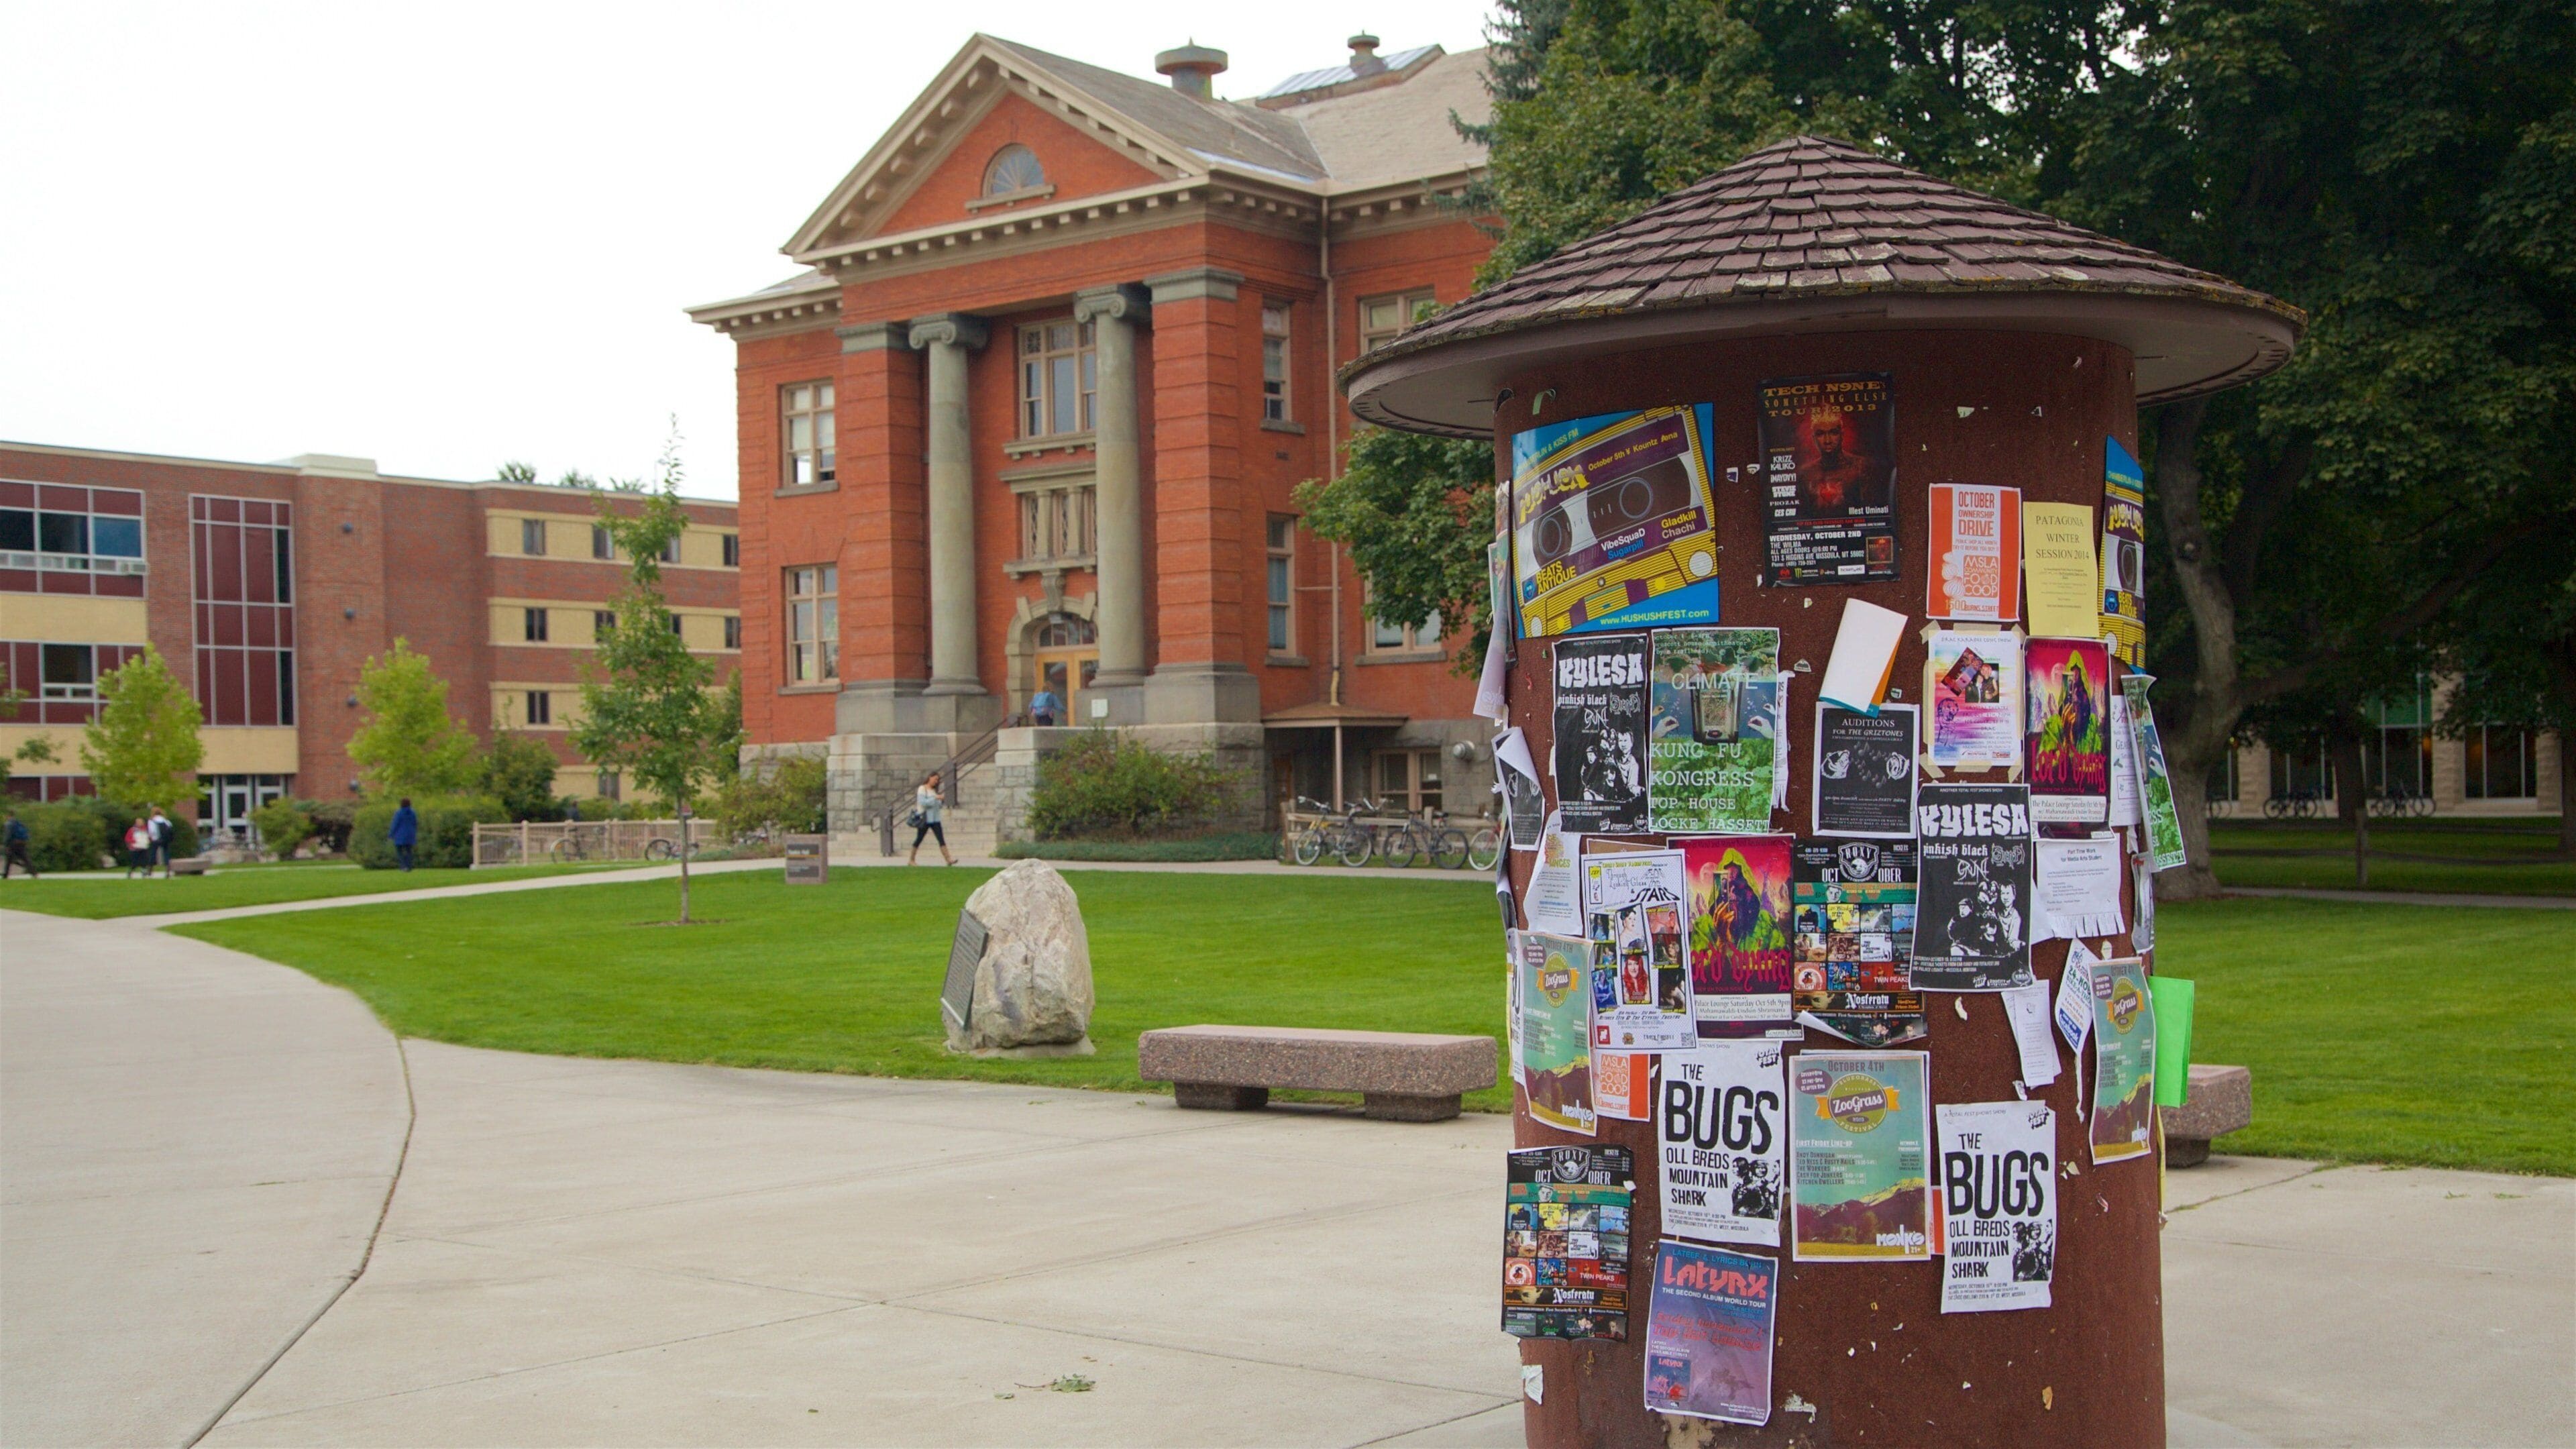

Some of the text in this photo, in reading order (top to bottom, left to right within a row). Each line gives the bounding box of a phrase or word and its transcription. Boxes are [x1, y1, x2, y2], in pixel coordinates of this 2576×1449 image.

[1764, 384, 1820, 397] TECH
[1764, 392, 1887, 409] SOMETHING ELSE
[1768, 404, 1876, 417] TOUR 2013
[1588, 438, 1659, 471] October 5th Kountz
[1773, 455, 1792, 463] KRIZZ
[1958, 491, 1994, 508] OCTOBER
[1848, 505, 1889, 515] Illest Uminati
[1958, 510, 1994, 519] OWNERSHIP
[1661, 510, 1697, 529] Gladkill
[2036, 515, 2084, 527] PATAGONIA
[1662, 521, 1696, 539] Chachi
[1959, 519, 1994, 537] DRIVE
[1601, 528, 1646, 551] VibeSquaD
[1770, 533, 1813, 542] WEDNESDAY,
[1815, 531, 1845, 539] OCTOBER
[2046, 533, 2080, 544] WINTER
[1608, 540, 1644, 559] Sugarpill
[2036, 549, 2090, 561] SESSION 2014
[1965, 556, 1997, 568] MSLA
[1536, 560, 1563, 581] BEATS
[1538, 566, 1576, 596] ANTIQUE
[2118, 591, 2133, 605] BEATS
[2118, 599, 2138, 618] ANTIQUE
[1600, 609, 1709, 625] www.HUSHUSHFEST.com
[1559, 653, 1644, 688] KYLESA
[1672, 673, 1758, 690] CLIMATE
[1558, 694, 1585, 706] pinkish
[1587, 694, 1607, 705] black
[1842, 718, 1895, 727] AUDITIONS
[1650, 743, 1741, 758] KUNG FU
[1650, 771, 1754, 787] KONGRESS
[1650, 798, 1735, 809] TOP HOUSE
[1649, 818, 1769, 830] LOCKE HASSETT
[1919, 804, 2029, 837] KYLESA
[1845, 846, 1872, 859] ROXY
[1962, 844, 1988, 857] black
[1822, 867, 1901, 882] OCT OBER
[1629, 887, 1680, 902] STARS
[1562, 942, 1573, 953] 4TH
[1545, 973, 1568, 989] ZooGrass
[1711, 1000, 1729, 1009] Lounge
[1845, 992, 1889, 1009] Nosferatu
[1602, 1056, 1627, 1068] MSLA
[1828, 1061, 1884, 1072] OCTOBER 4TH
[1681, 1064, 1704, 1081] THE
[1839, 1075, 1876, 1085] BLUEGRASS
[1833, 1094, 1883, 1114] ZooGrass
[1665, 1080, 1779, 1155] BUGS
[1839, 1122, 1878, 1132] FESTIVAL
[1958, 1133, 1982, 1150] THE
[1559, 1150, 1584, 1162] ROXY
[1666, 1147, 1729, 1170] OLL BREDS
[1536, 1170, 1611, 1185] OCT OBER
[1669, 1168, 1728, 1189] MOUNTAIN
[1945, 1150, 2049, 1220] BUGS
[1672, 1188, 1707, 1206] SHARK
[1949, 1220, 2010, 1238] OLL BREDS
[1672, 1249, 1699, 1258] LATEEF
[1712, 1255, 1738, 1265] LYRICS
[1951, 1240, 2009, 1259] MOUNTAIN
[1951, 1262, 1989, 1279] SHARK
[1552, 1287, 1595, 1305] Nosferatu
[1675, 1289, 1702, 1298] SECOND
[1703, 1293, 1723, 1301] ALBUM
[1724, 1297, 1748, 1305] WORLD
[1748, 1301, 1766, 1309] TOUR
